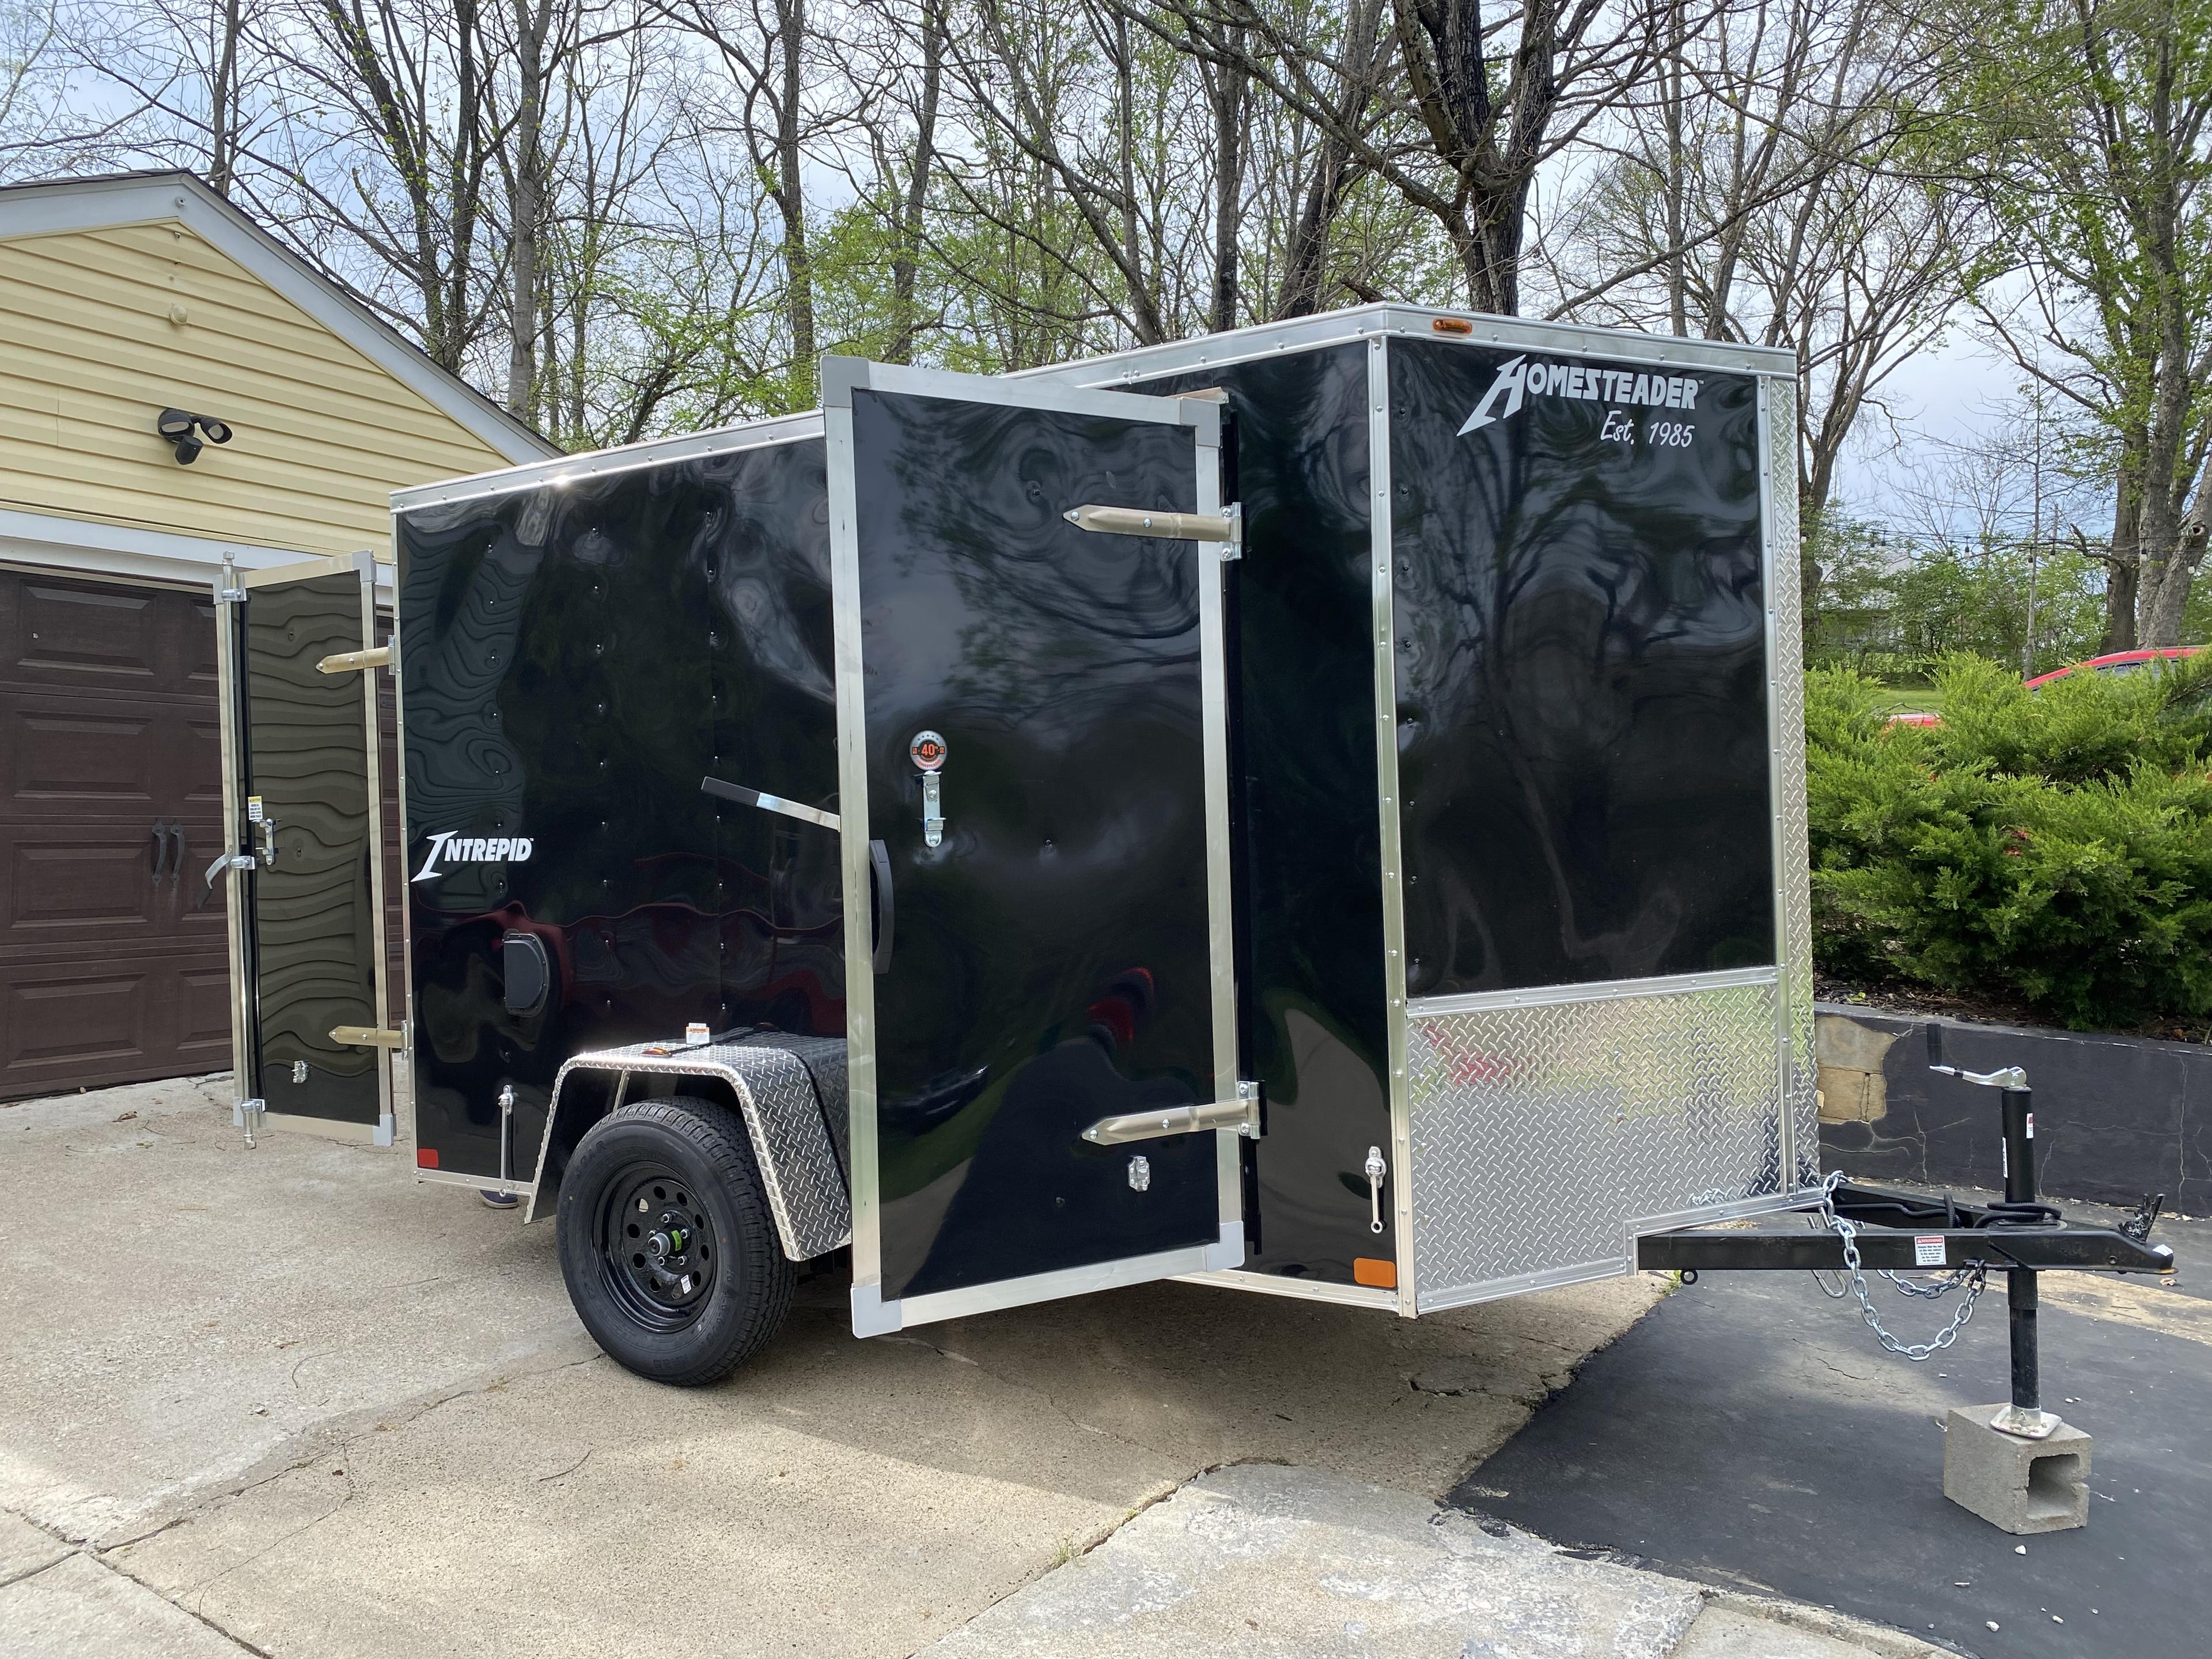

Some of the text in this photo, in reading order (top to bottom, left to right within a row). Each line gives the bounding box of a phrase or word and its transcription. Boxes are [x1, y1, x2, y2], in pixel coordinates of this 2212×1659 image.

[1457, 354, 1698, 437] HOMESTEADER
[1600, 410, 1695, 448] Est. 1985
[411, 830, 532, 882] INTREPID
